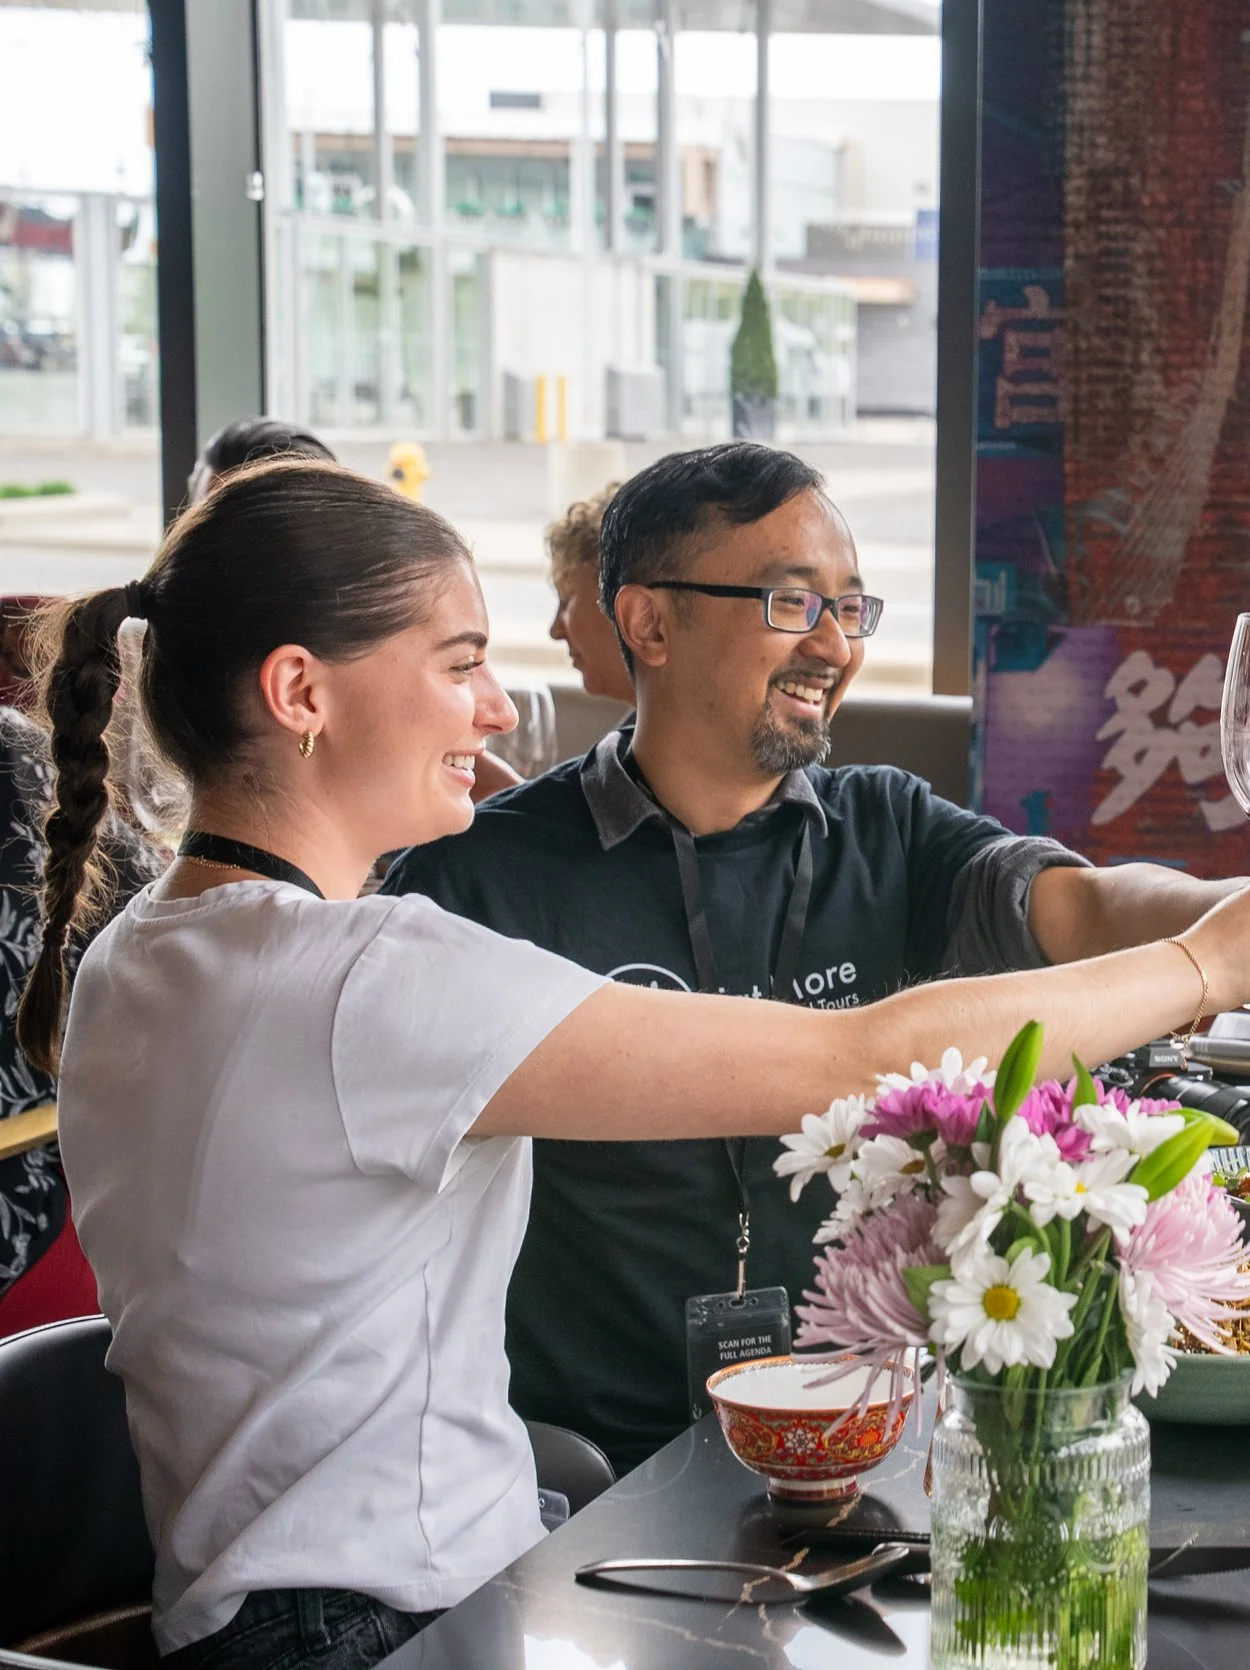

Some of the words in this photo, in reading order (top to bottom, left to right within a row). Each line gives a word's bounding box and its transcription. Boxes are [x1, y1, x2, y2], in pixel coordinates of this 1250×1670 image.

[770, 961, 857, 1000] lore
[1154, 1055, 1178, 1063] SONY
[718, 1340, 740, 1350] SCAN
[741, 1337, 756, 1347] FOR
[757, 1335, 772, 1344] THE
[720, 1350, 738, 1360] FULL
[740, 1346, 772, 1357] AGENDA
